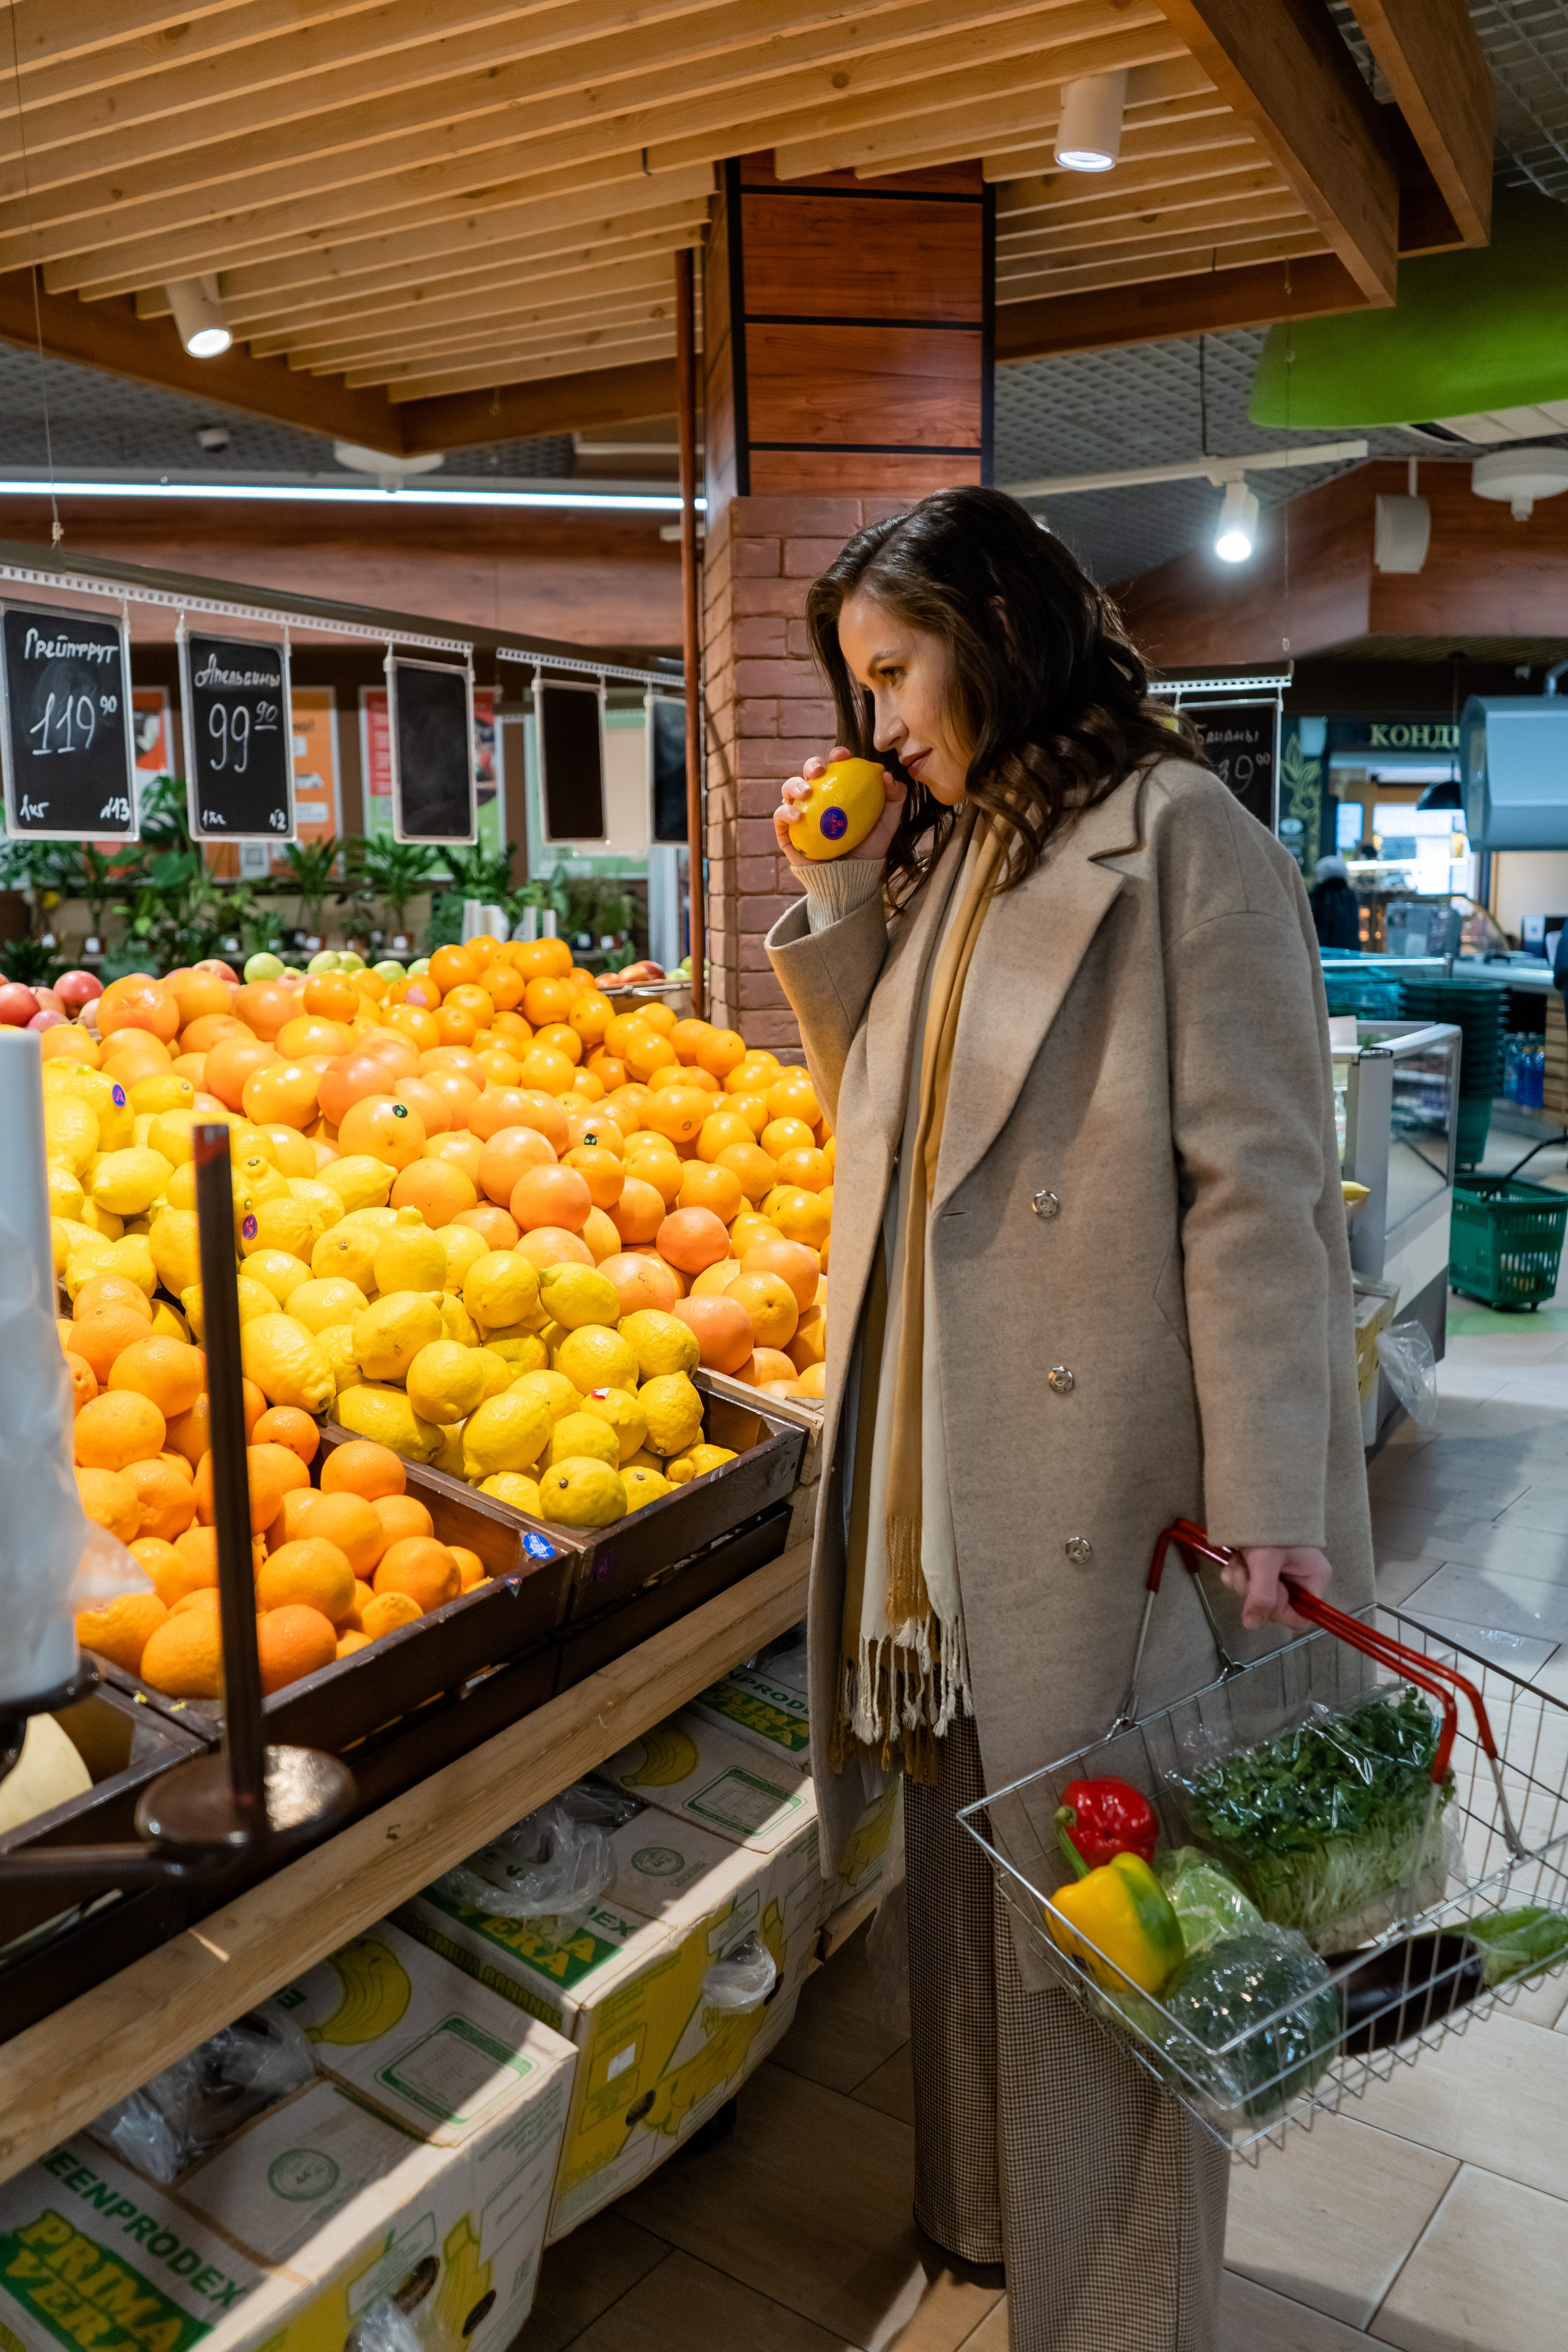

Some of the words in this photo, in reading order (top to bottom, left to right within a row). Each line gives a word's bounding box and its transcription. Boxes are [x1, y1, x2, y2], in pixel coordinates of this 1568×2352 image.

[29, 693, 96, 755] 119
[99, 695, 118, 715] 90
[208, 703, 249, 773] 99
